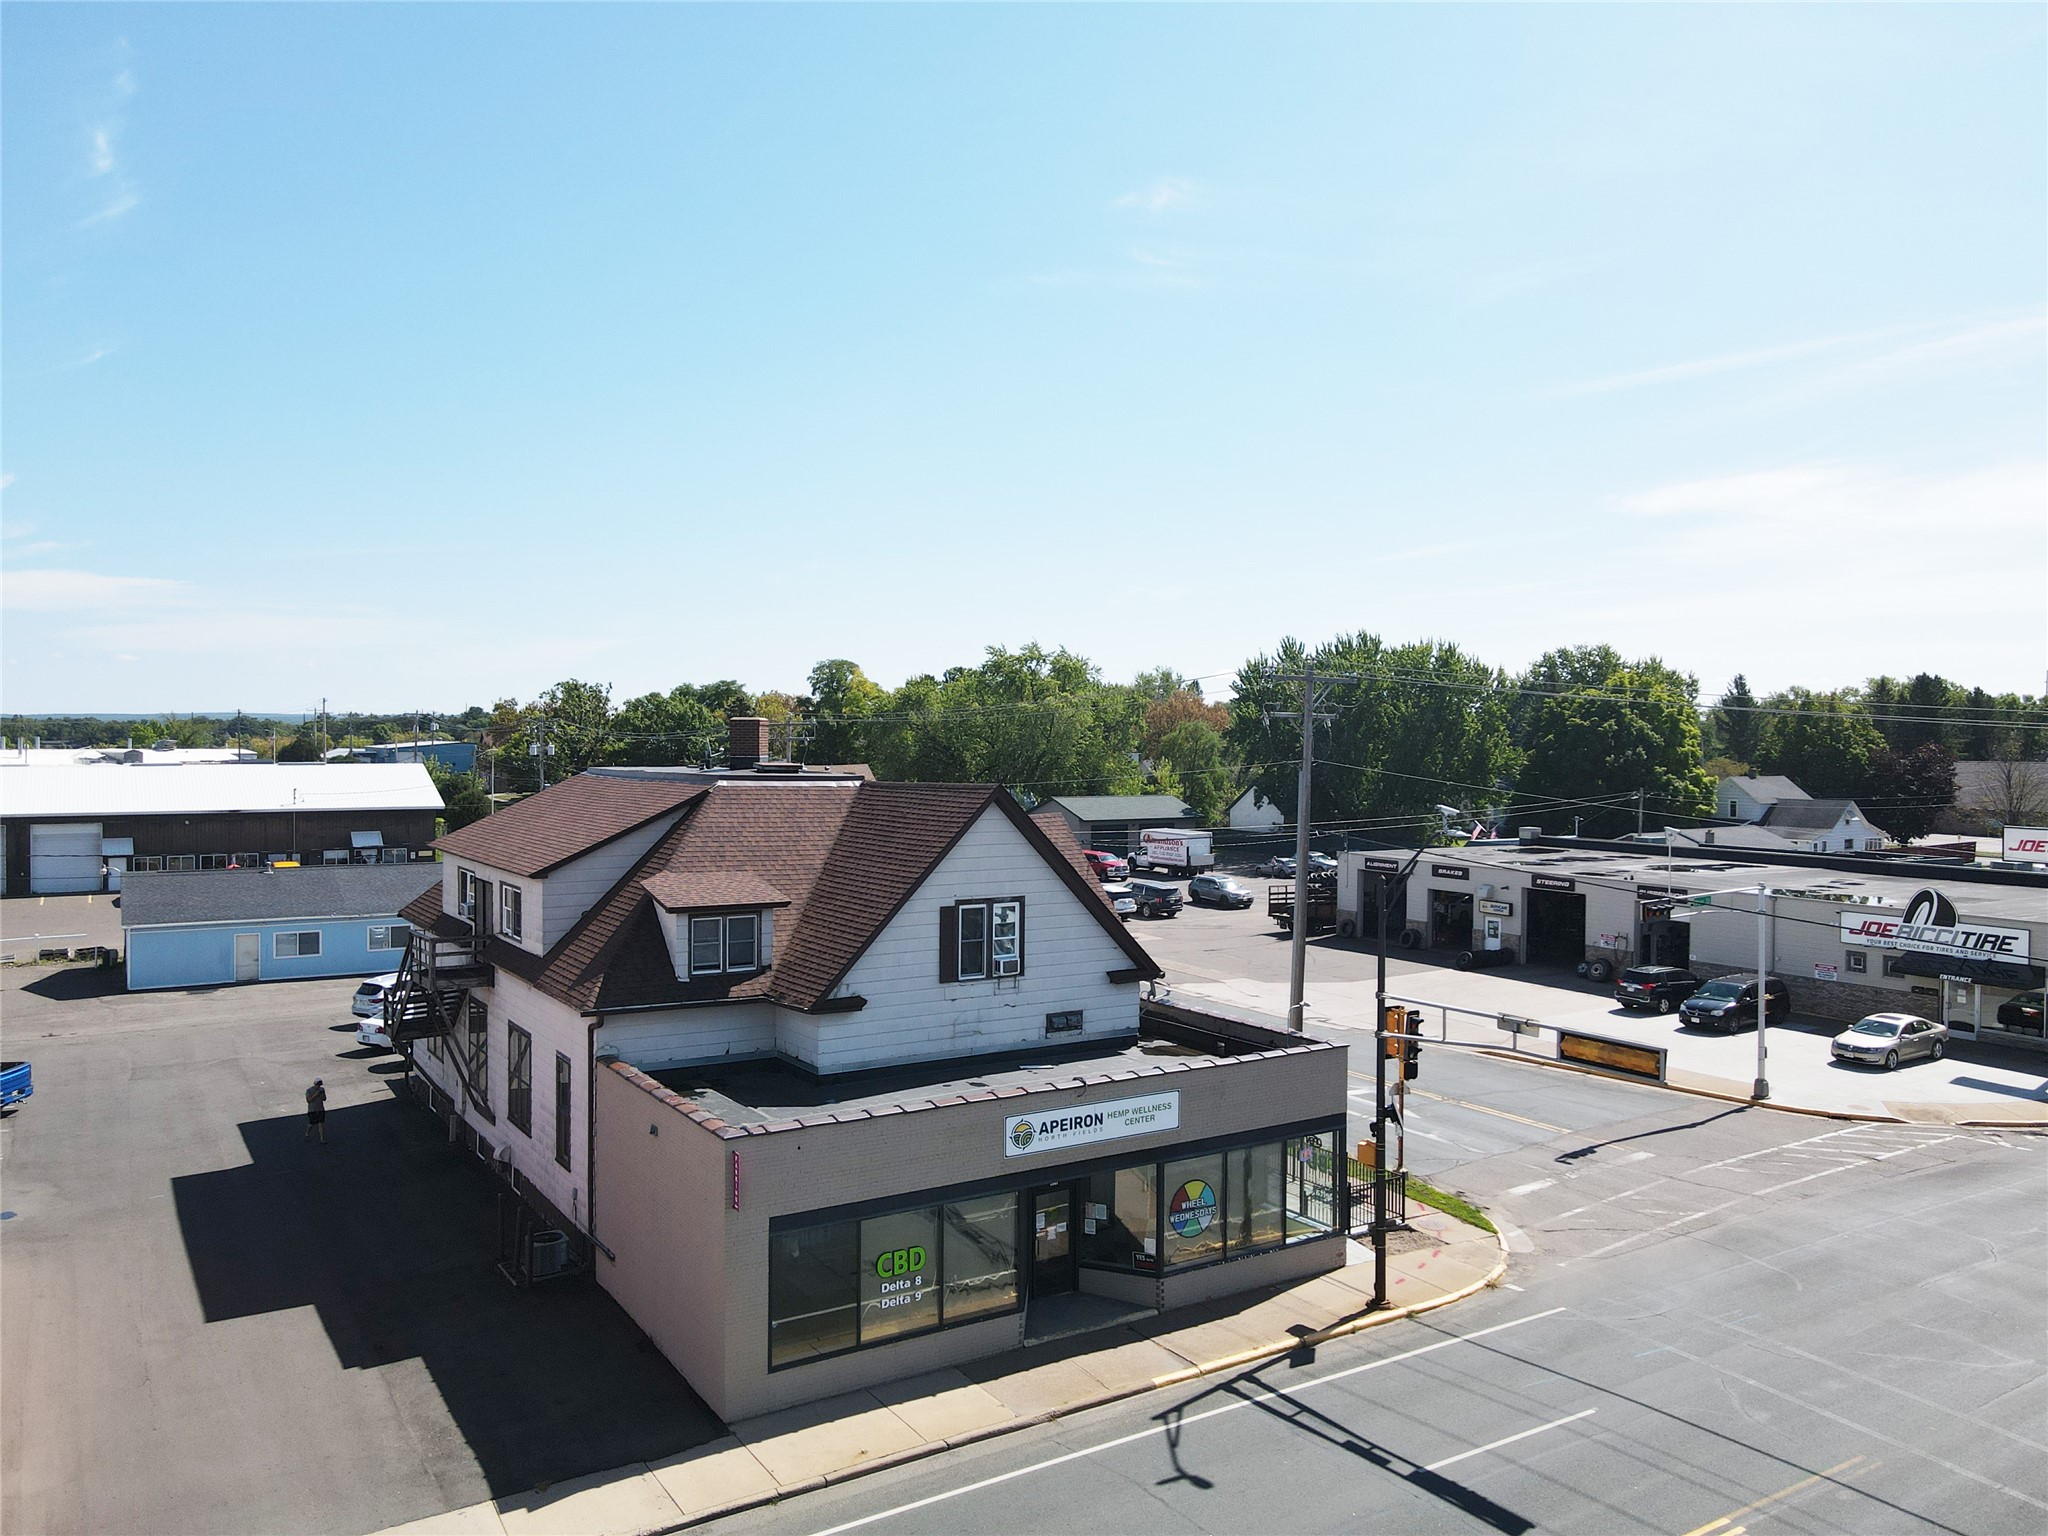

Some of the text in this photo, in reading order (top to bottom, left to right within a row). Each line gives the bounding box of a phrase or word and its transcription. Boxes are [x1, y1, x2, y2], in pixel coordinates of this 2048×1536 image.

[1438, 868, 1463, 876] BRAKES
[1536, 878, 1570, 888] STEERING
[1866, 938, 1997, 959] YOUR BEST CHOICE FOR TIRES AND SERVICE
[1939, 973, 1973, 984] ENTRANCE
[1107, 1102, 1172, 1120] HEMP WELLNESS
[1124, 1114, 1156, 1126] CENTER
[1039, 1112, 1104, 1136] APEIRON
[1038, 1126, 1104, 1142] NORTH FIELDS
[1181, 1197, 1207, 1210] WHEEL
[1169, 1205, 1217, 1224] WEDNESDAYS
[877, 1246, 926, 1278] CBD
[881, 1275, 922, 1293] Delta 8
[881, 1291, 922, 1309] Delta 9
